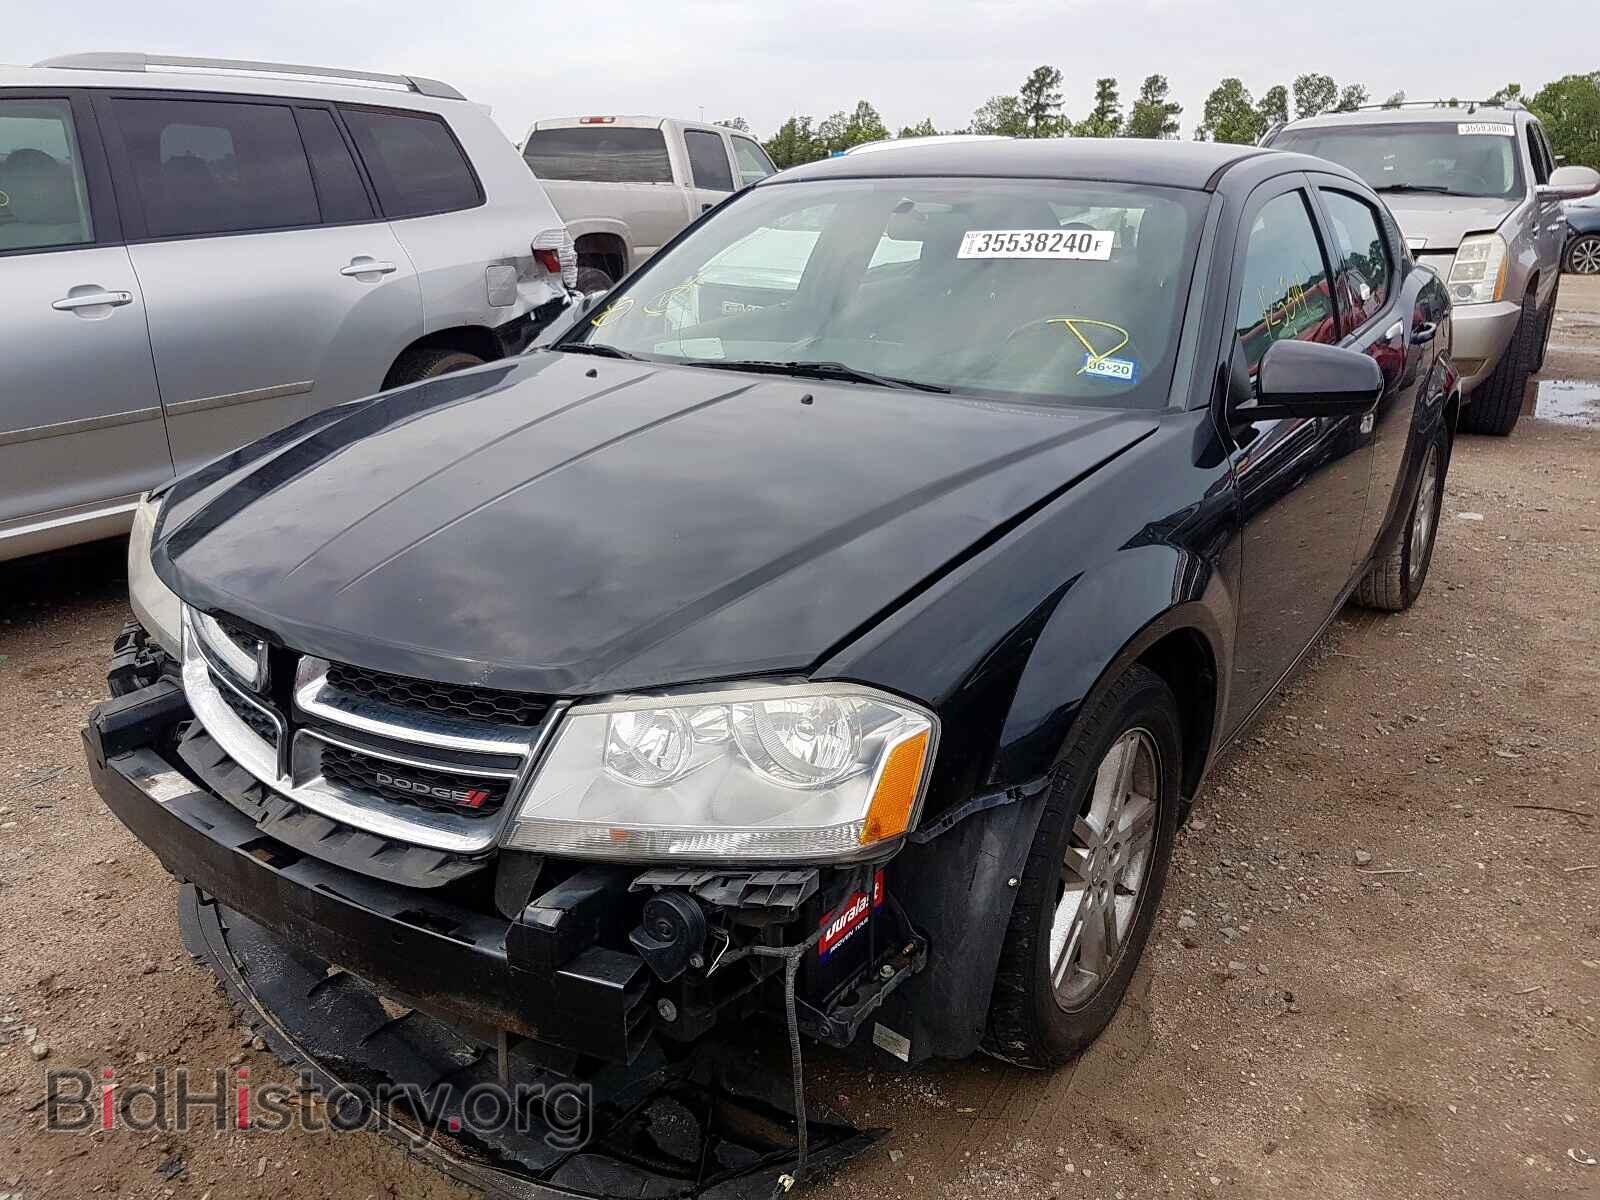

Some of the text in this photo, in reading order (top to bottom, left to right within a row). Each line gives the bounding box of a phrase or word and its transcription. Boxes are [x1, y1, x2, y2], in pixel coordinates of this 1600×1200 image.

[977, 232, 1093, 253] 35538240
[1094, 240, 1104, 252] F
[376, 773, 472, 802] DODGE
